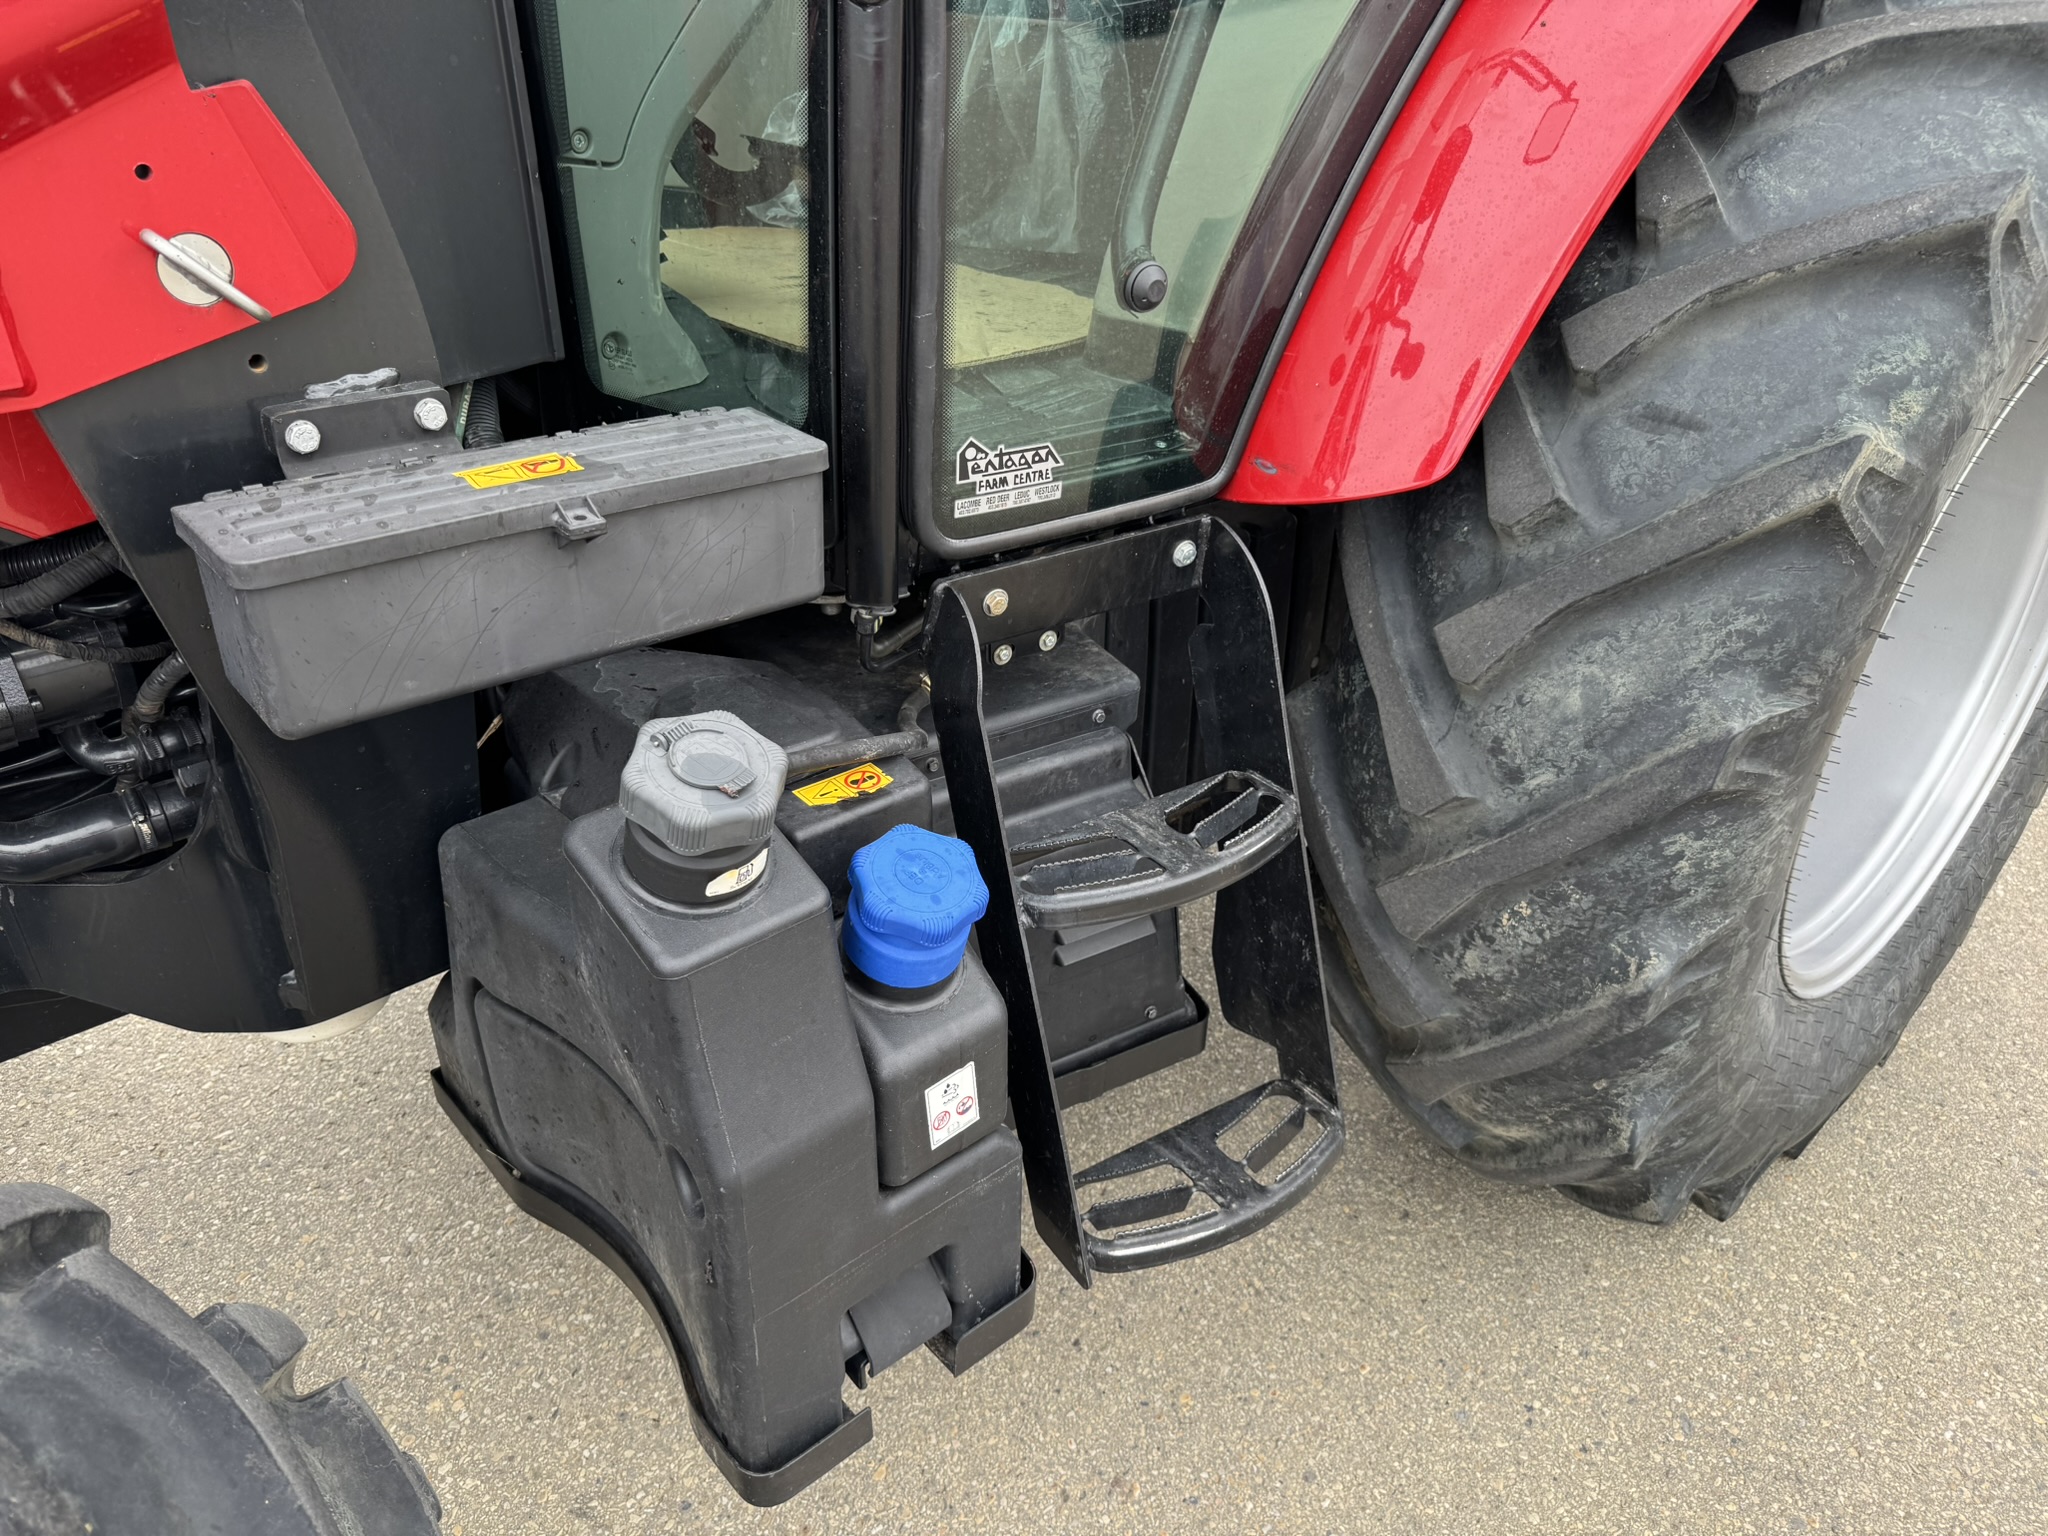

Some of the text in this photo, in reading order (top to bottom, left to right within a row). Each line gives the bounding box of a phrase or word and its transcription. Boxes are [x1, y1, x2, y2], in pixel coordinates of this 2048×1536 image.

[958, 439, 1061, 481] Pentagon
[978, 468, 1051, 492] FARM CENTRE
[956, 498, 982, 511] LACOMBE
